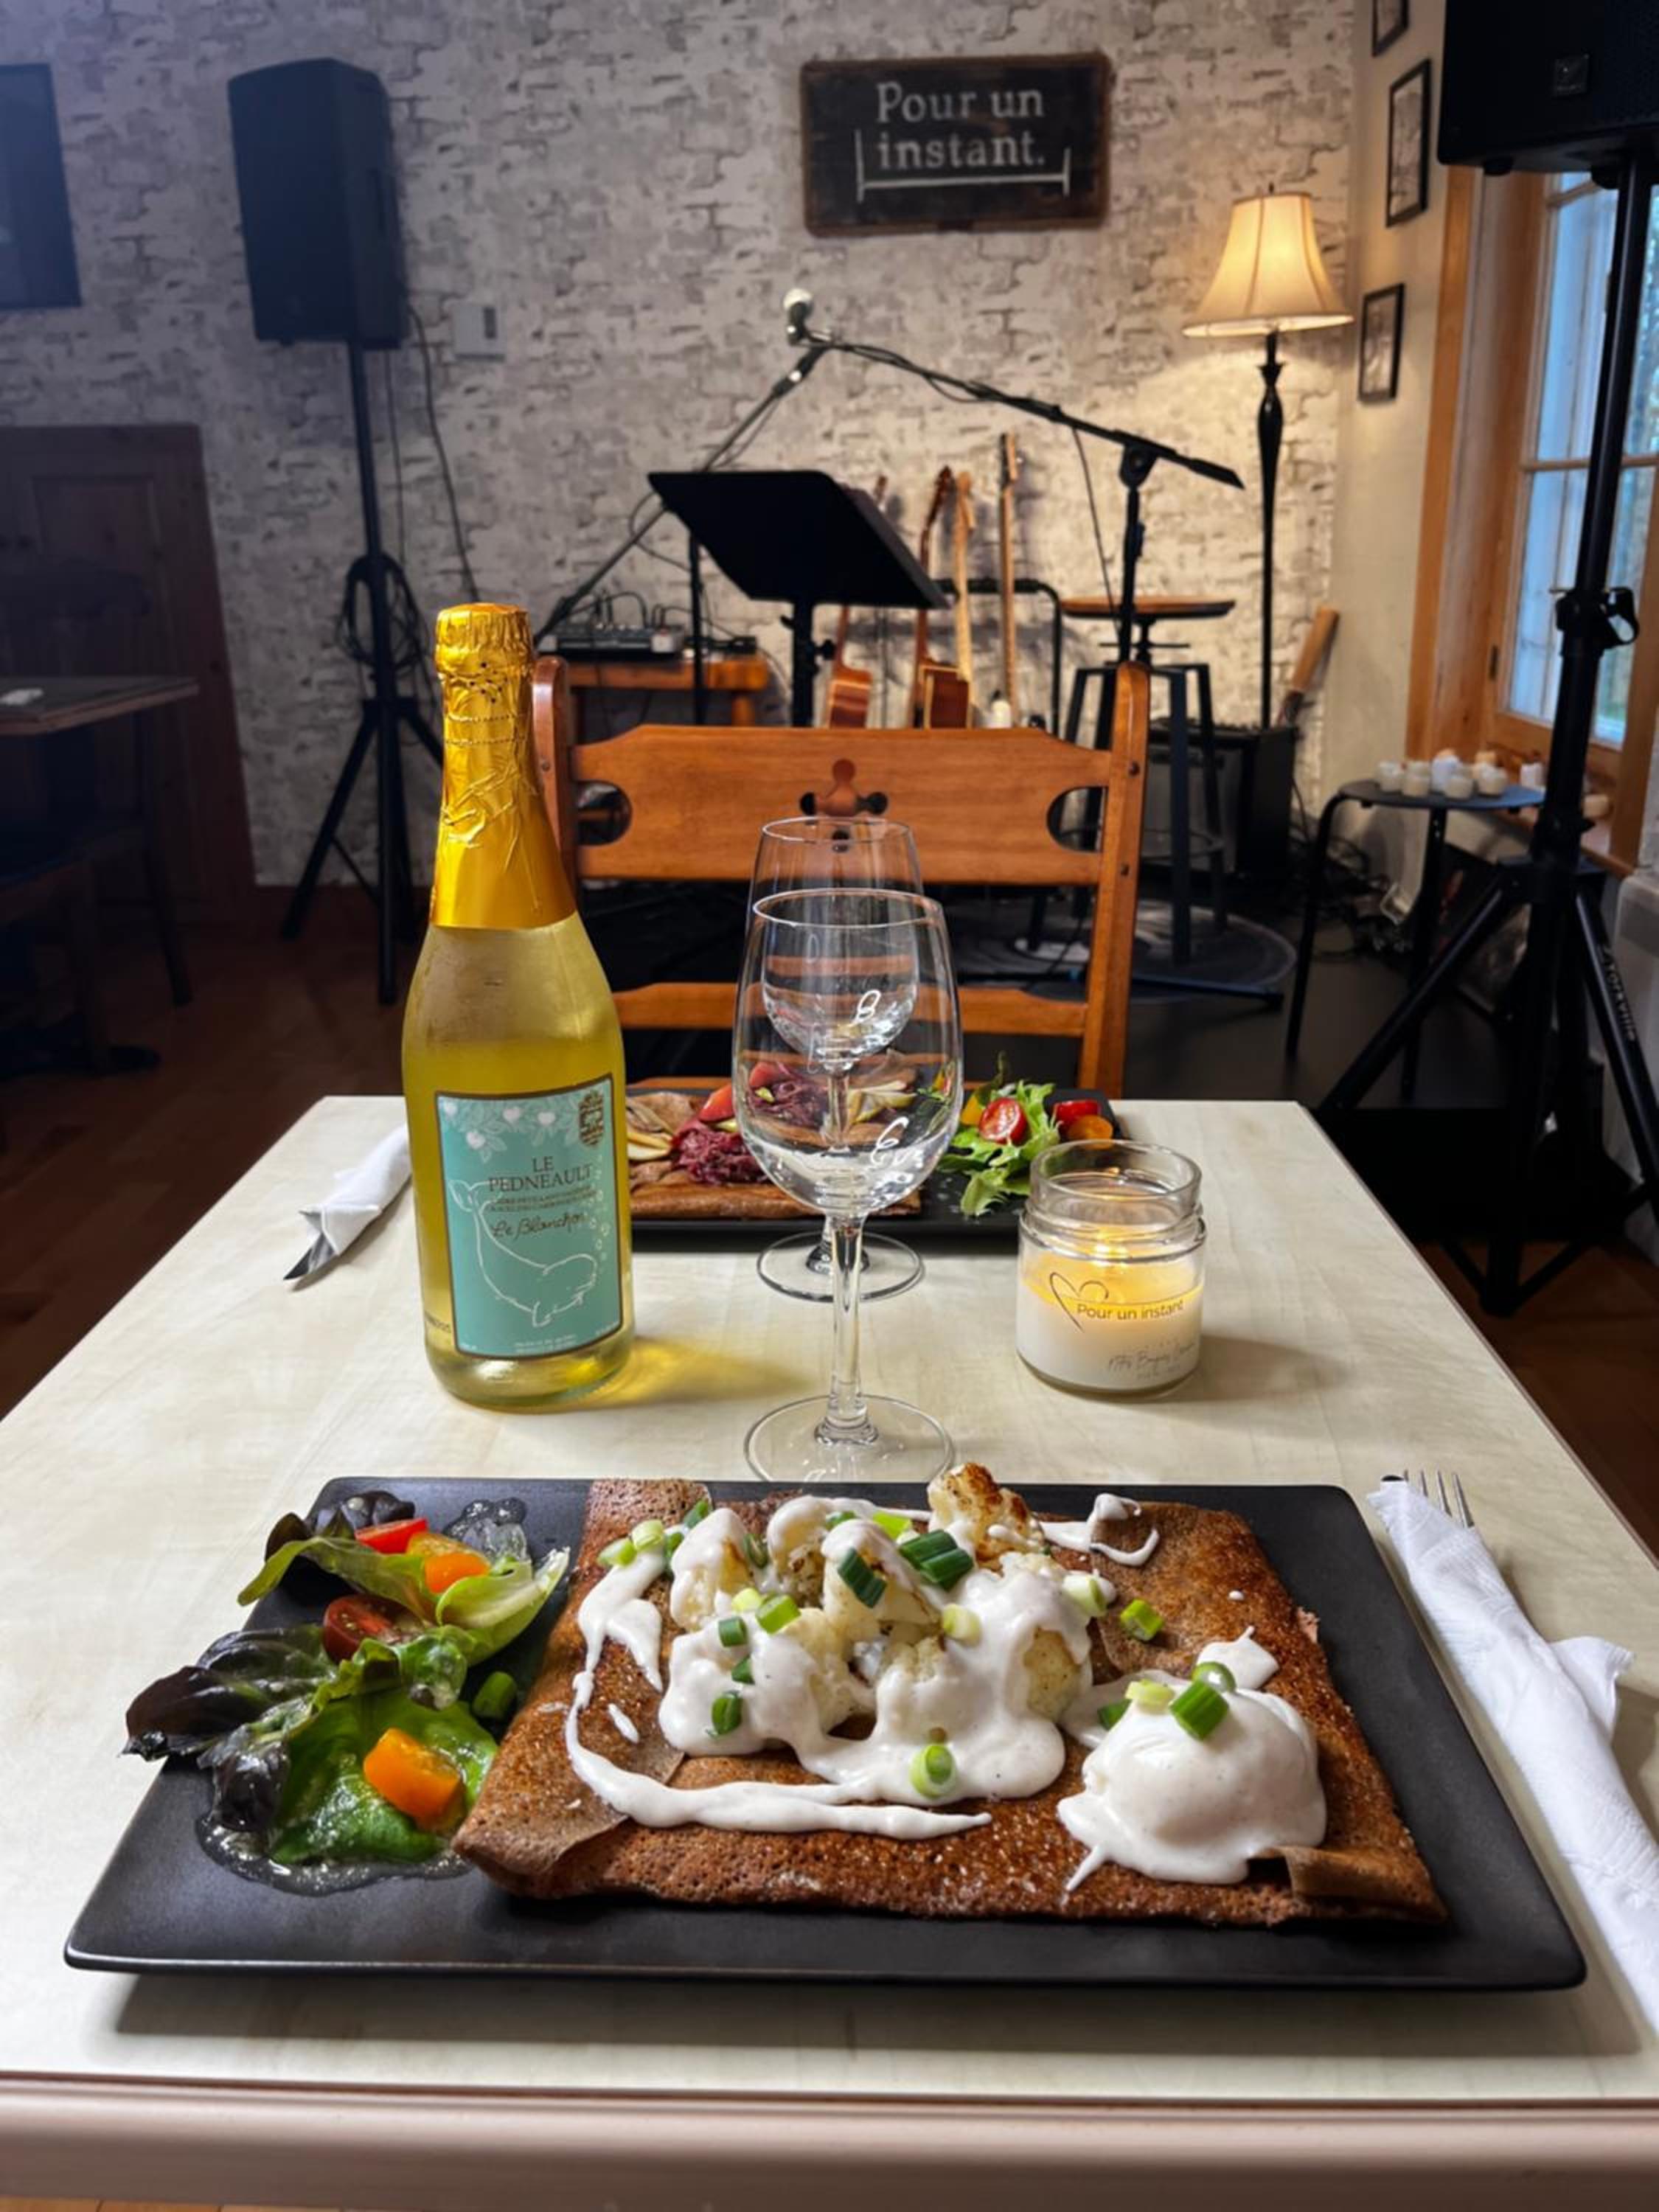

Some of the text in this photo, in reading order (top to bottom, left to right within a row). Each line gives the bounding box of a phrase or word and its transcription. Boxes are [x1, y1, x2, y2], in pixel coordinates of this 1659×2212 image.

[875, 81, 1045, 122] Pour un
[877, 131, 1046, 170] instant.
[532, 1155, 554, 1172] LE
[488, 1163, 593, 1192] PEDNEAULT
[492, 1220, 512, 1238] Le
[1077, 1300, 1183, 1321] Pour un instant
